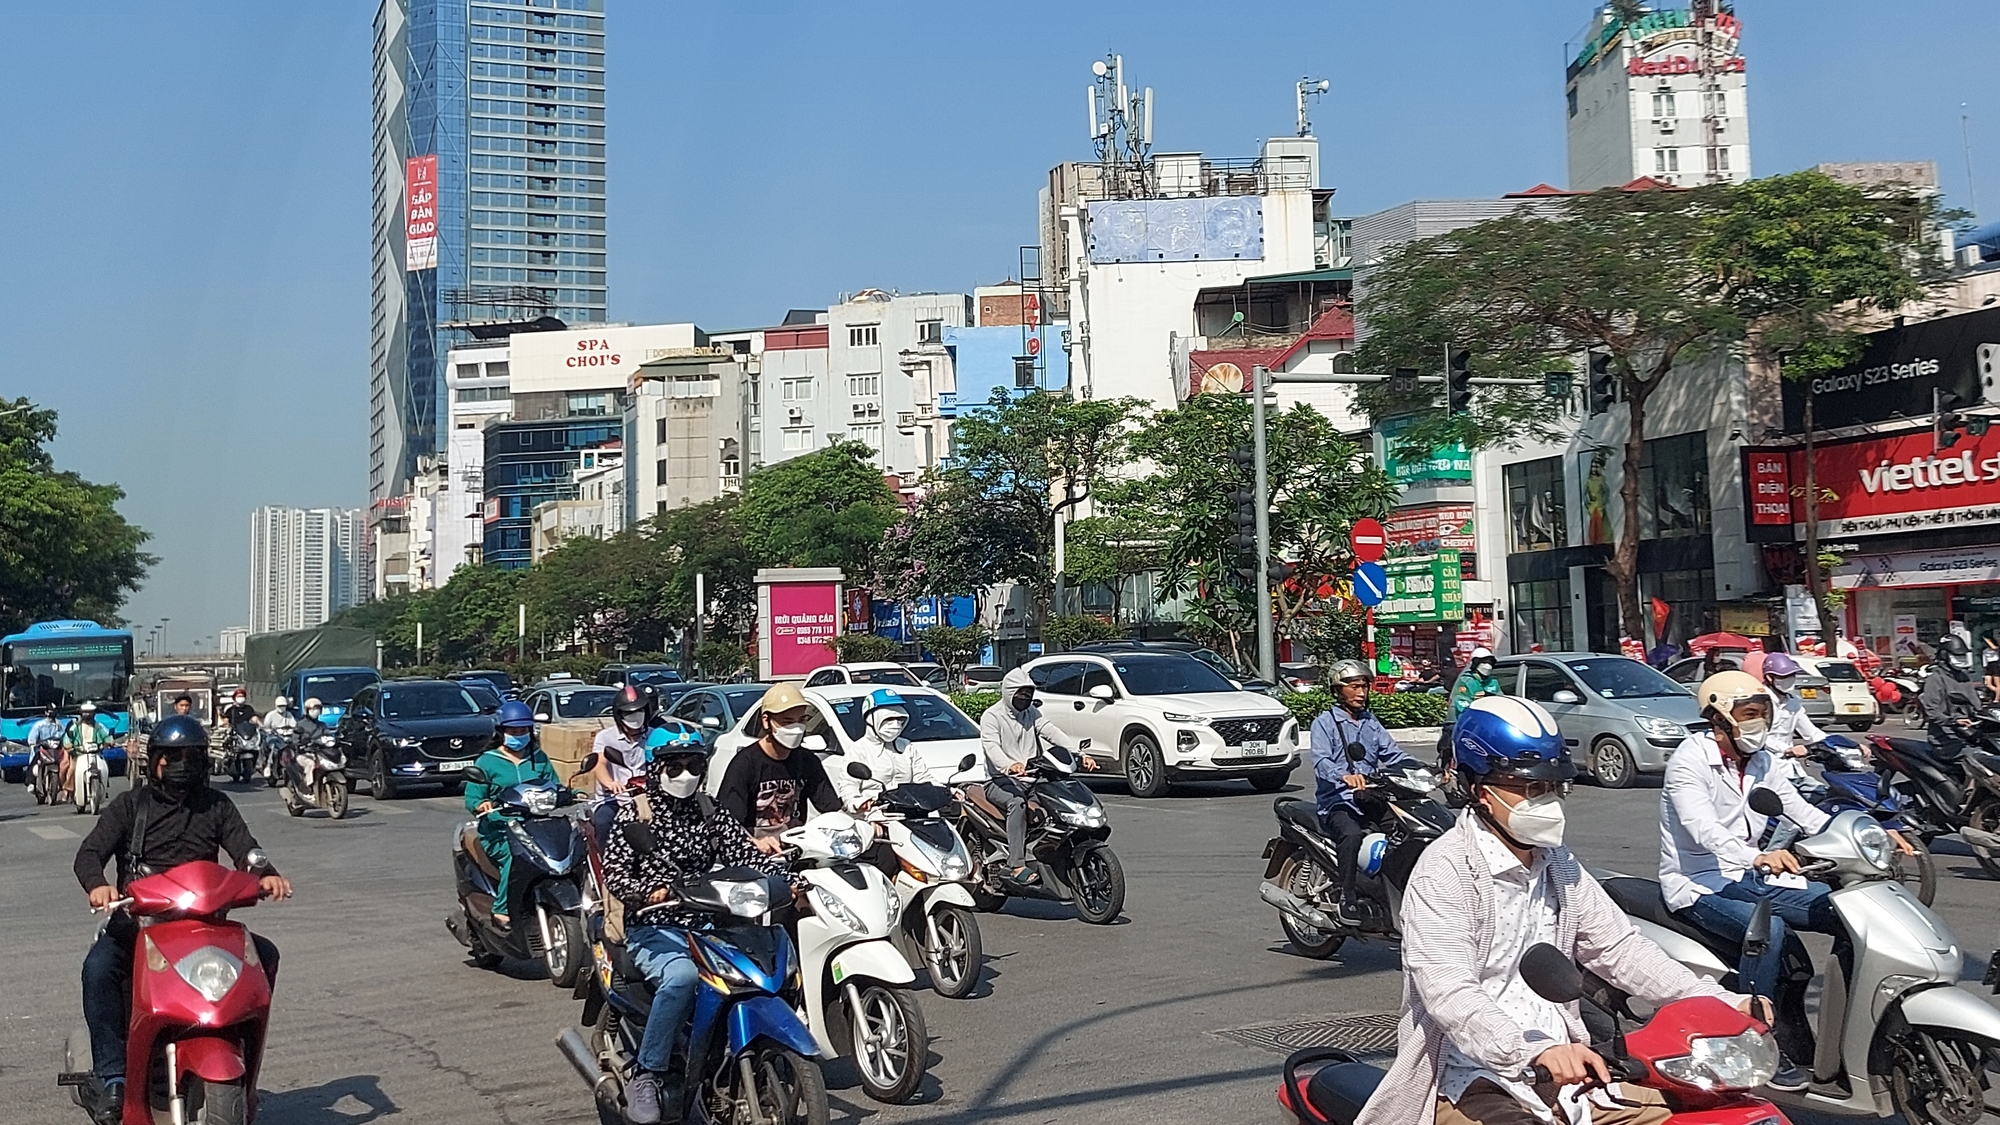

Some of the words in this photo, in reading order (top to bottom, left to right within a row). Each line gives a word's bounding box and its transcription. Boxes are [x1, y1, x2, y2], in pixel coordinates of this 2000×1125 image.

[410, 205, 433, 220] BÀN
[408, 221, 434, 235] GIAO
[577, 339, 609, 351] SPA
[566, 354, 621, 368] CHOI'S
[1811, 373, 1863, 394] Galaxy
[1864, 366, 1889, 385] S23
[1890, 357, 1940, 380] Series
[1858, 450, 1980, 493] viettel
[1758, 480, 1784, 496] ĐIỆN
[1755, 503, 1790, 517] THOẠI
[1441, 538, 1475, 547] CHERRY
[1440, 552, 1458, 563] TRÁI
[1919, 562, 1950, 574] Galaxy
[1968, 557, 1998, 569] Series
[791, 612, 817, 624] QUẢNG
[818, 612, 834, 623] CÁO
